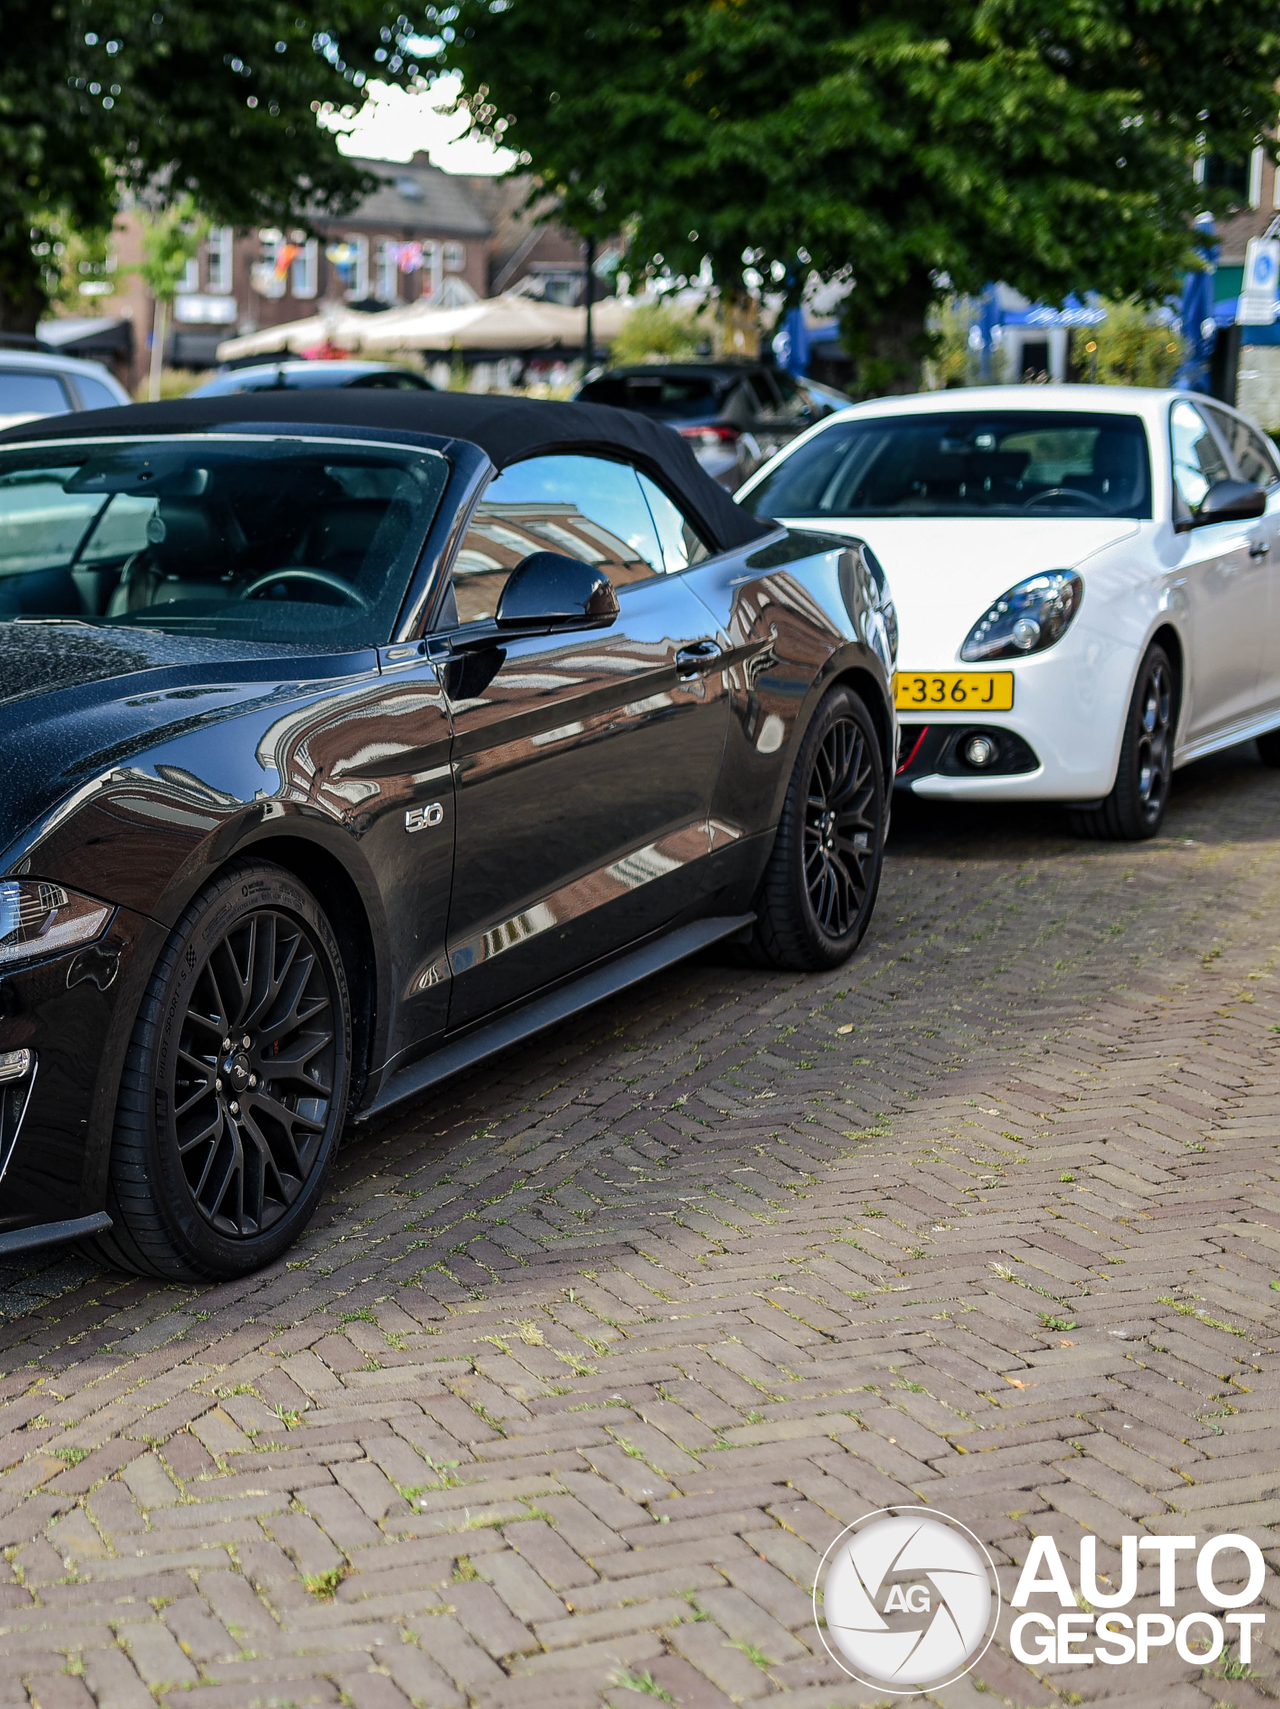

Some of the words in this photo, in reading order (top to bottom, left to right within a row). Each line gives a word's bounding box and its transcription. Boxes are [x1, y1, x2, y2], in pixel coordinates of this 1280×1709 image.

[405, 802, 444, 833] 5.0
[158, 1038, 169, 1080] PILOT
[165, 991, 181, 1036] SPORT
